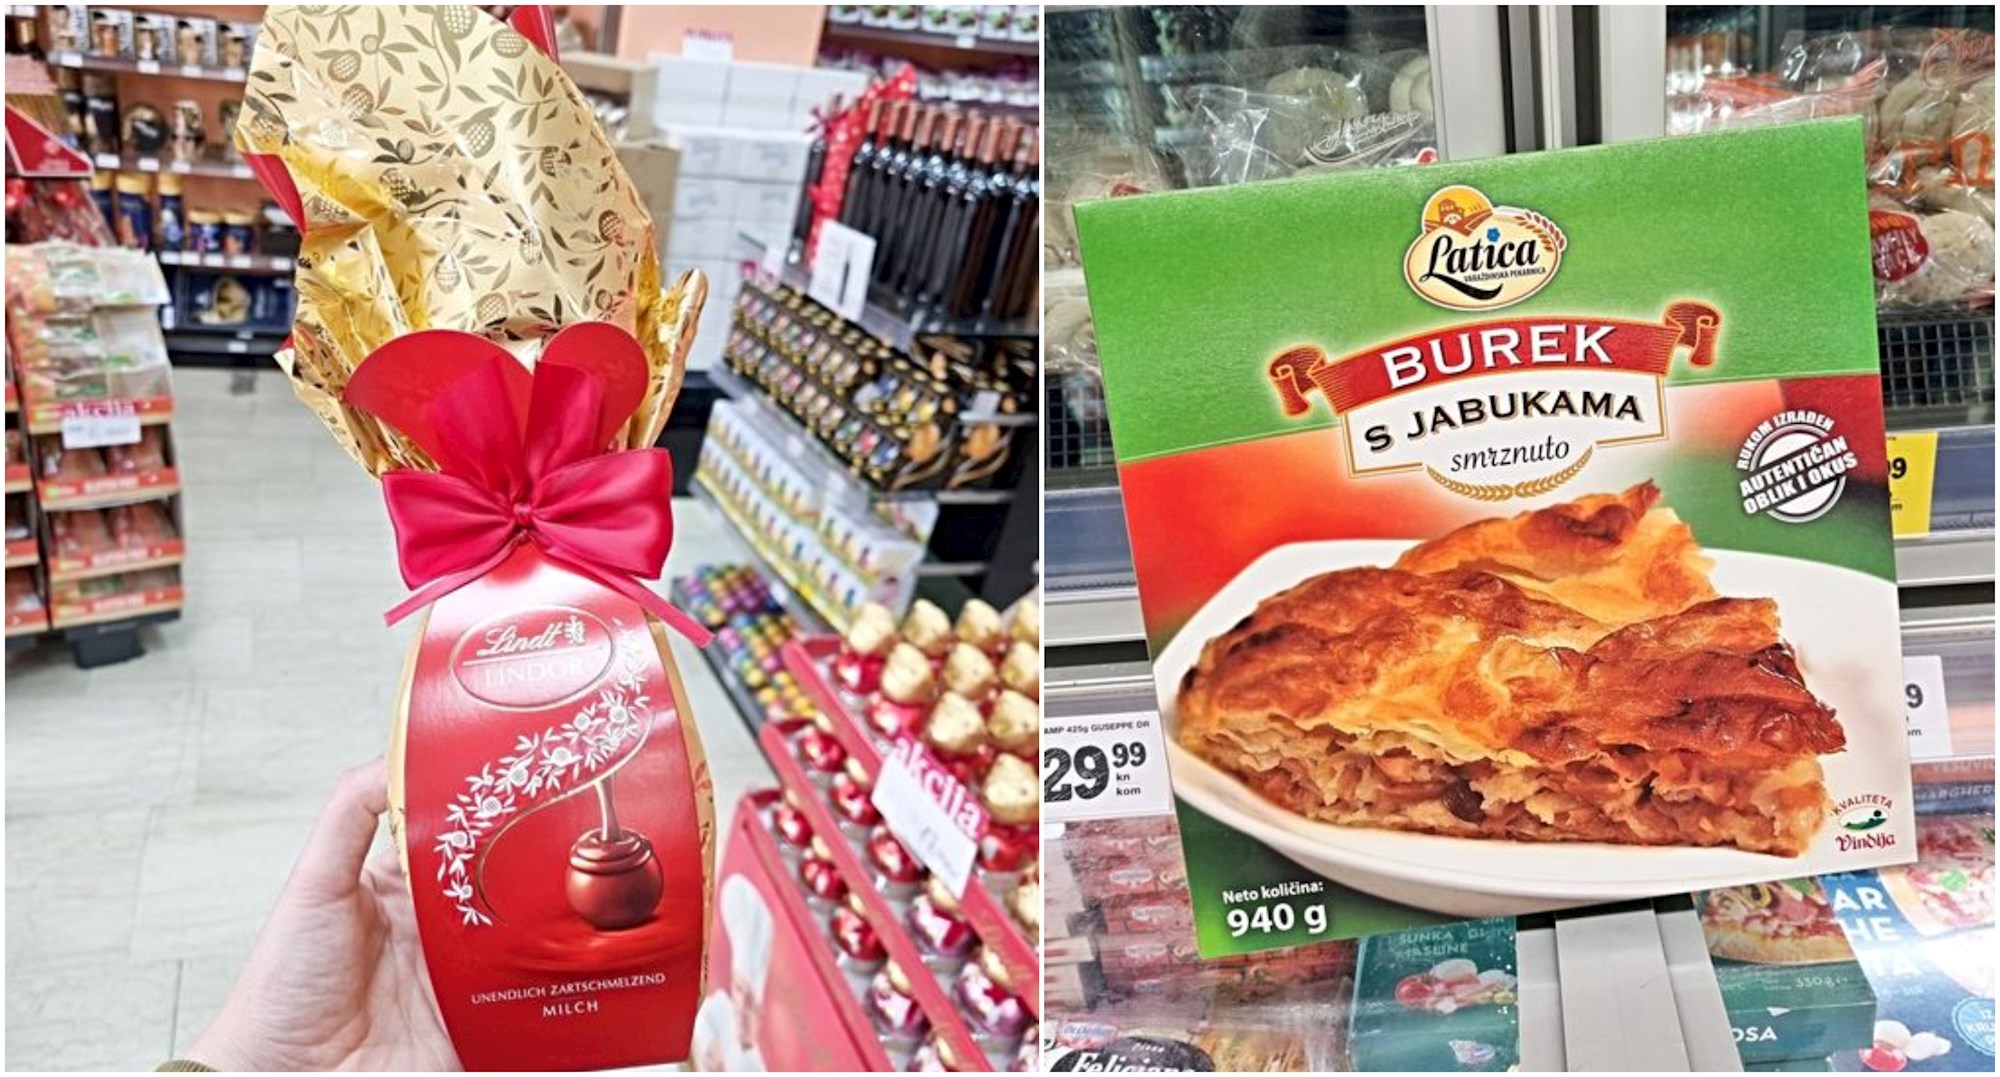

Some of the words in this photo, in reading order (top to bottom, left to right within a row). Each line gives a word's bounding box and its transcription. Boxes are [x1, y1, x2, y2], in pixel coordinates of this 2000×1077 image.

[1420, 234, 1540, 301] Latica
[1510, 267, 1546, 279] PEKARNICA
[1380, 324, 1616, 390] BUREK
[1364, 424, 1393, 452] S
[1407, 389, 1644, 440] JABUKAMA
[1449, 435, 1570, 473] smrznuto
[1736, 420, 1774, 471] RUKOM
[1739, 435, 1849, 498] AUTENTIČAN
[1742, 483, 1798, 515] OBLIK
[1796, 476, 1809, 491] I
[1807, 452, 1859, 487] OKUS
[476, 621, 564, 657] Lindt
[486, 659, 583, 688] LINDOR
[1044, 744, 1110, 803] 29
[1111, 741, 1147, 769] 99
[1115, 772, 1131, 782] kn
[1115, 786, 1141, 796] kom
[1831, 794, 1893, 817] KVALITETA
[1835, 832, 1896, 852] Vindija
[1222, 889, 1259, 905] Neto
[1260, 881, 1324, 899] količina:
[1833, 886, 1888, 911] AR
[1226, 902, 1295, 938] 940
[1303, 904, 1328, 935] g
[470, 986, 546, 1004] UNENDLICH
[550, 973, 666, 997] ZARTSCHMELZEND
[542, 1001, 599, 1018] MILCH
[1731, 1025, 1778, 1042] OSA
